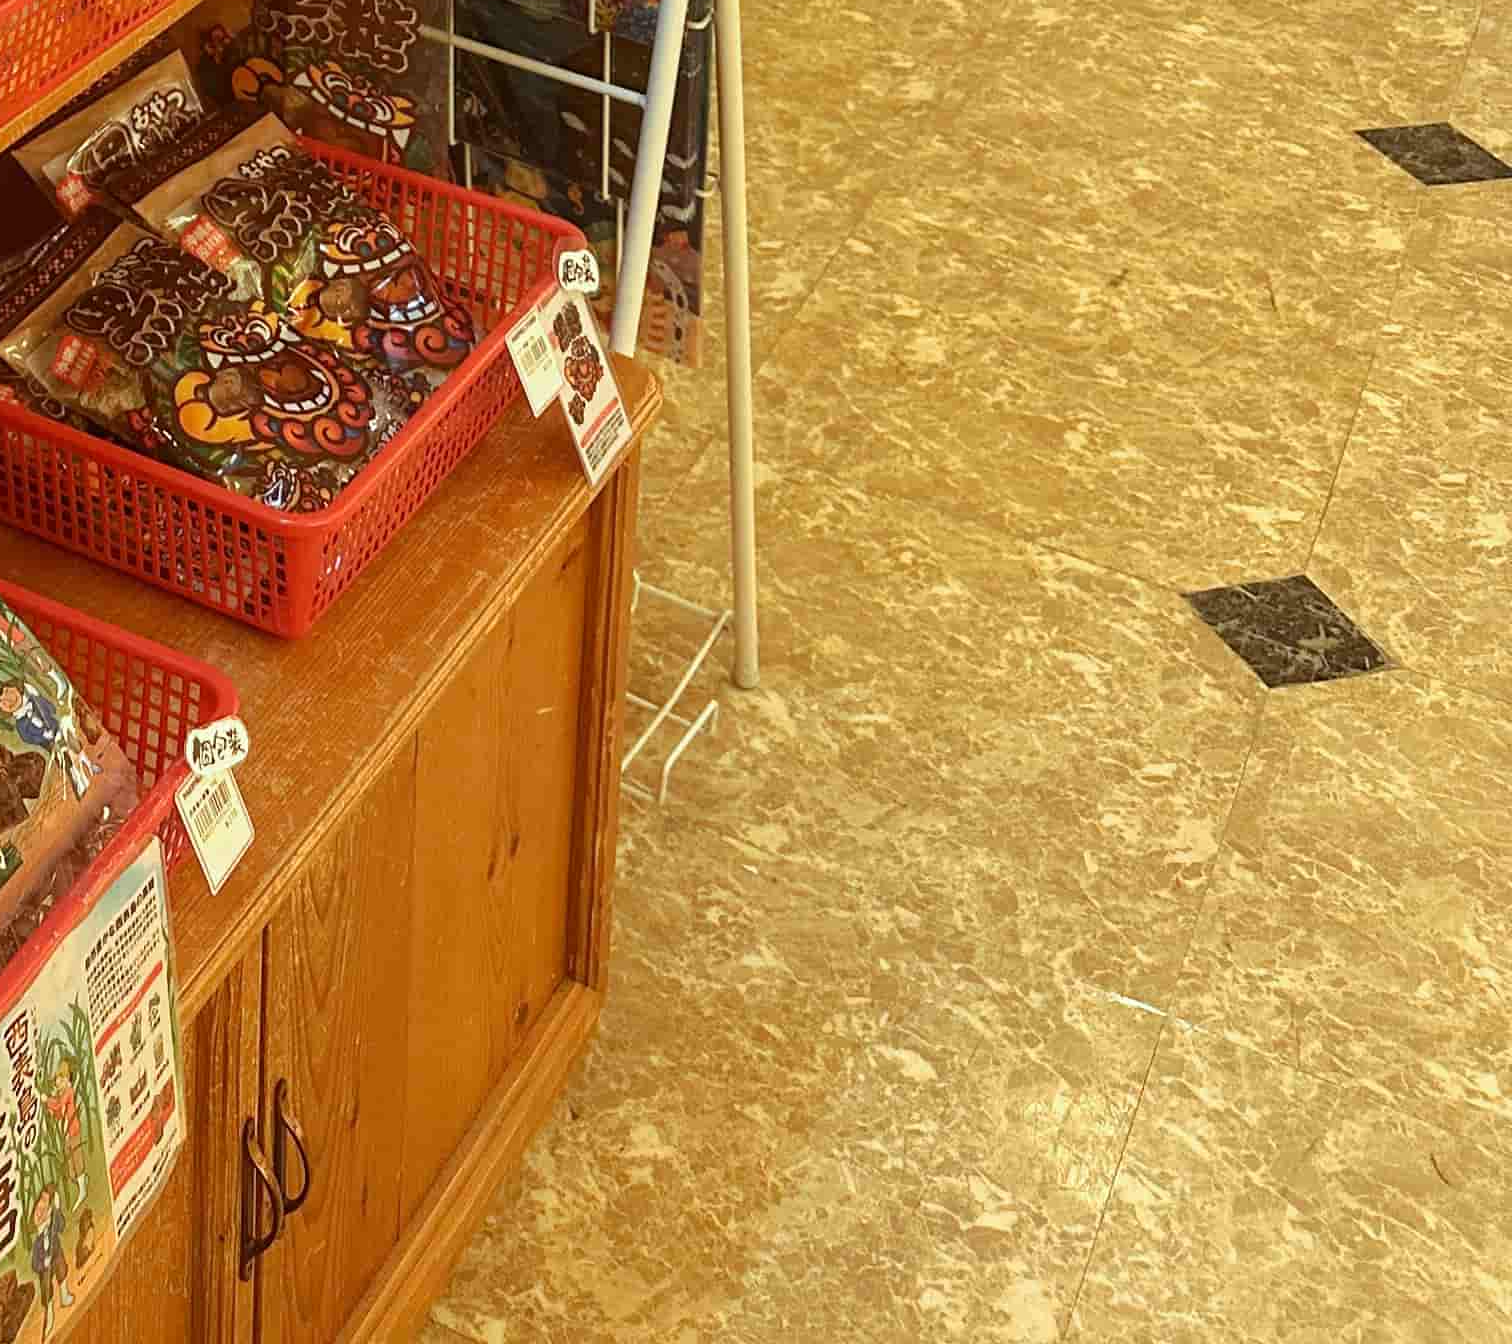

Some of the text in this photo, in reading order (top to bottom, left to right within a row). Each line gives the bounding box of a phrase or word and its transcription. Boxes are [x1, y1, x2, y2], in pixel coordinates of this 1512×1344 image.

[131, 89, 185, 129] おやつ
[239, 145, 291, 179] おやつ
[3, 1009, 39, 1150] 西表島の
